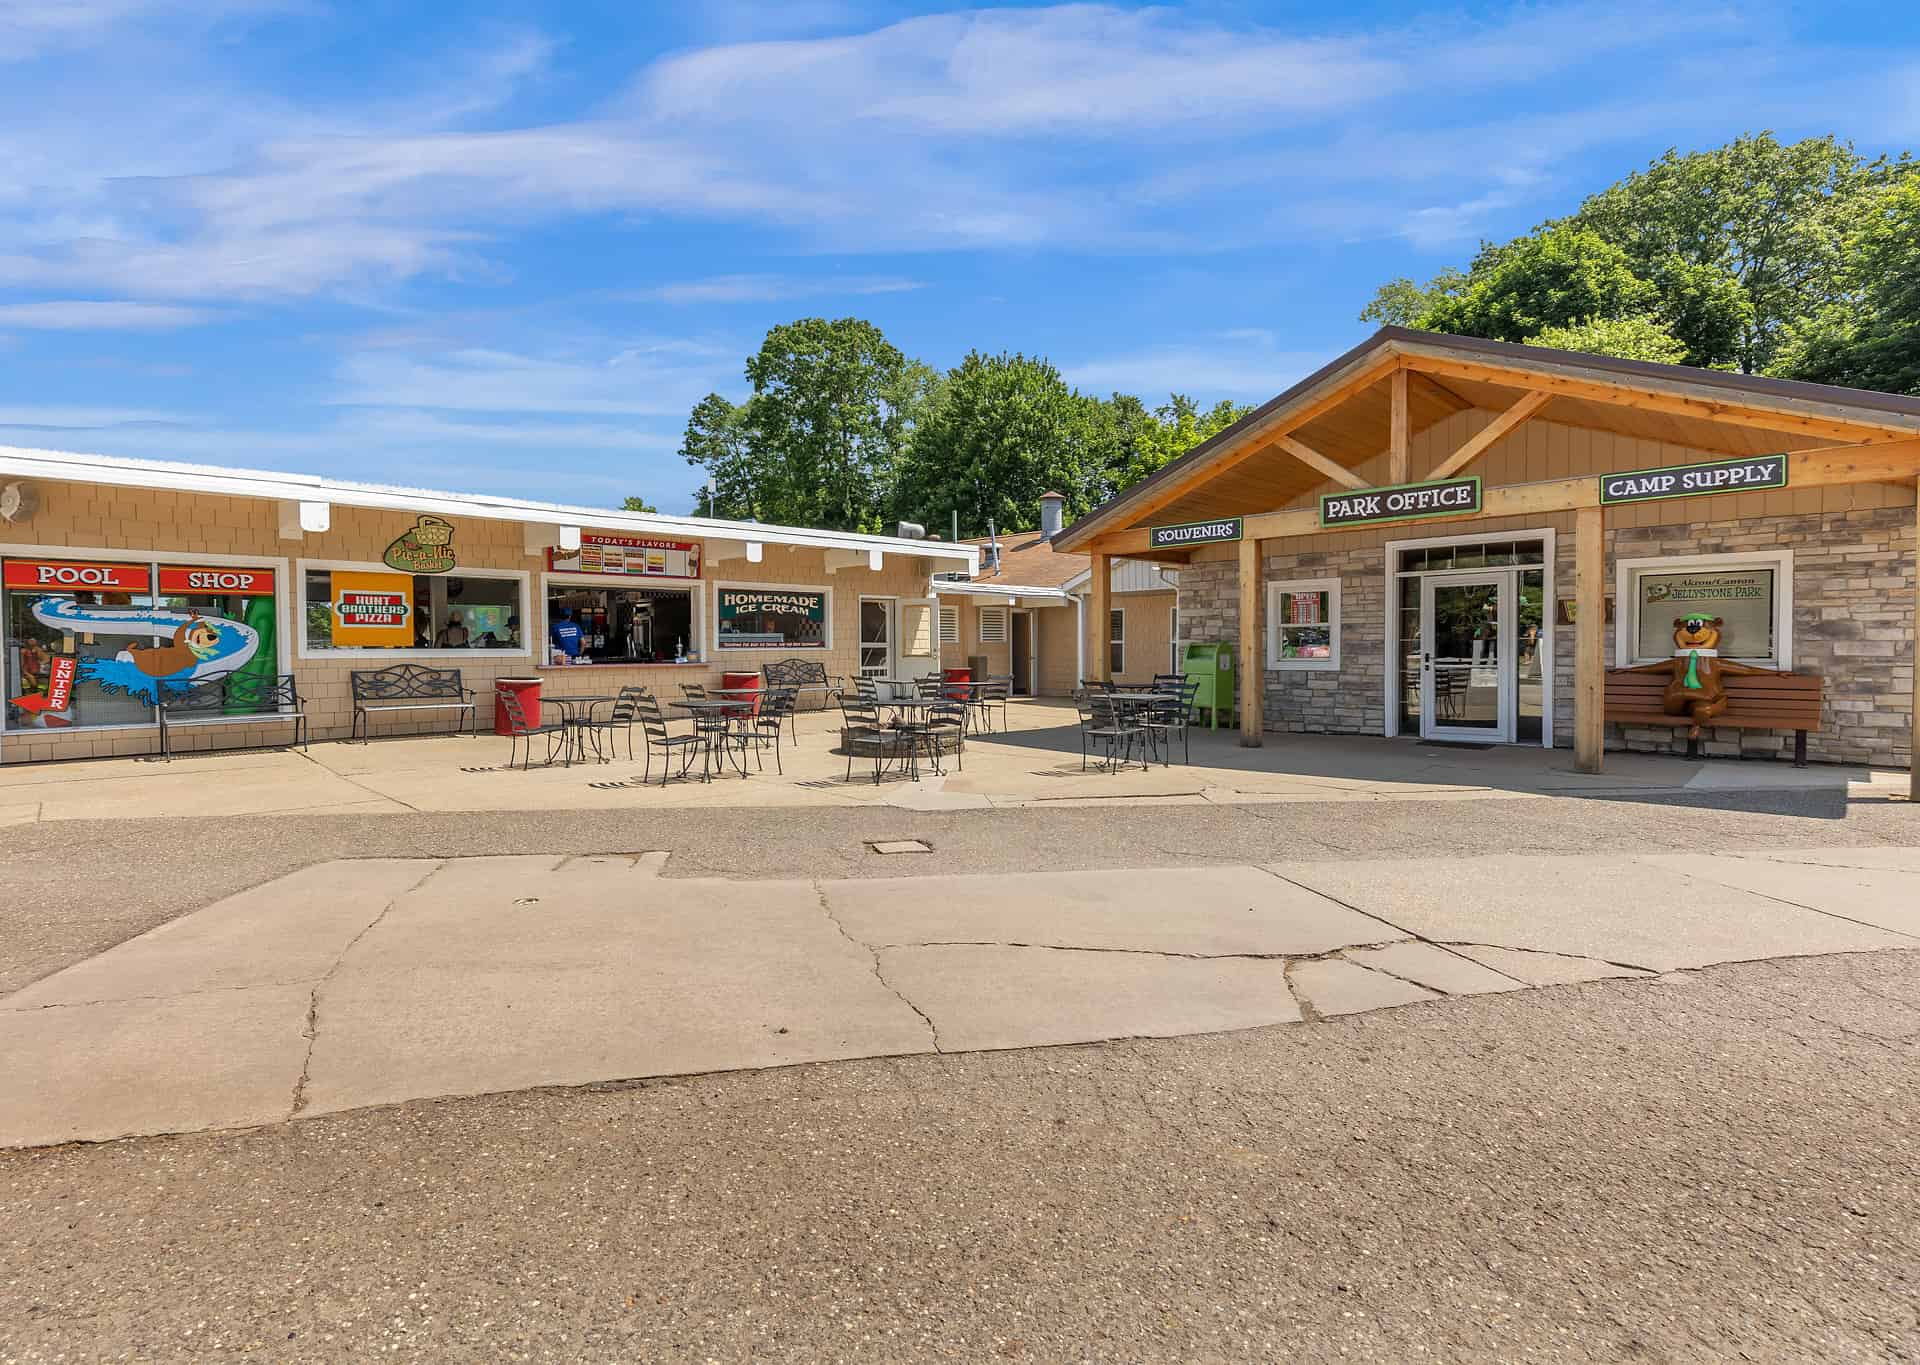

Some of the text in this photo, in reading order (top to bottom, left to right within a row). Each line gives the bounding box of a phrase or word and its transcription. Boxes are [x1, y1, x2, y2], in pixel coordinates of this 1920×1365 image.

[1609, 464, 1776, 496] CAMP SUPPLY
[1327, 485, 1471, 518] PARK OFFICE
[1158, 523, 1233, 542] SOUVENIRS
[591, 536, 676, 549] TODAY'S FLAVORS
[38, 566, 254, 589] POOL SHOP
[1736, 586, 1761, 597] PARK
[355, 595, 391, 605] HUNT
[724, 594, 818, 609] HOMEMADE
[341, 605, 404, 614] BROTHERS
[735, 604, 809, 616] ICE CREAM
[355, 614, 392, 623] PIZZA
[50, 660, 73, 709] ENTER
